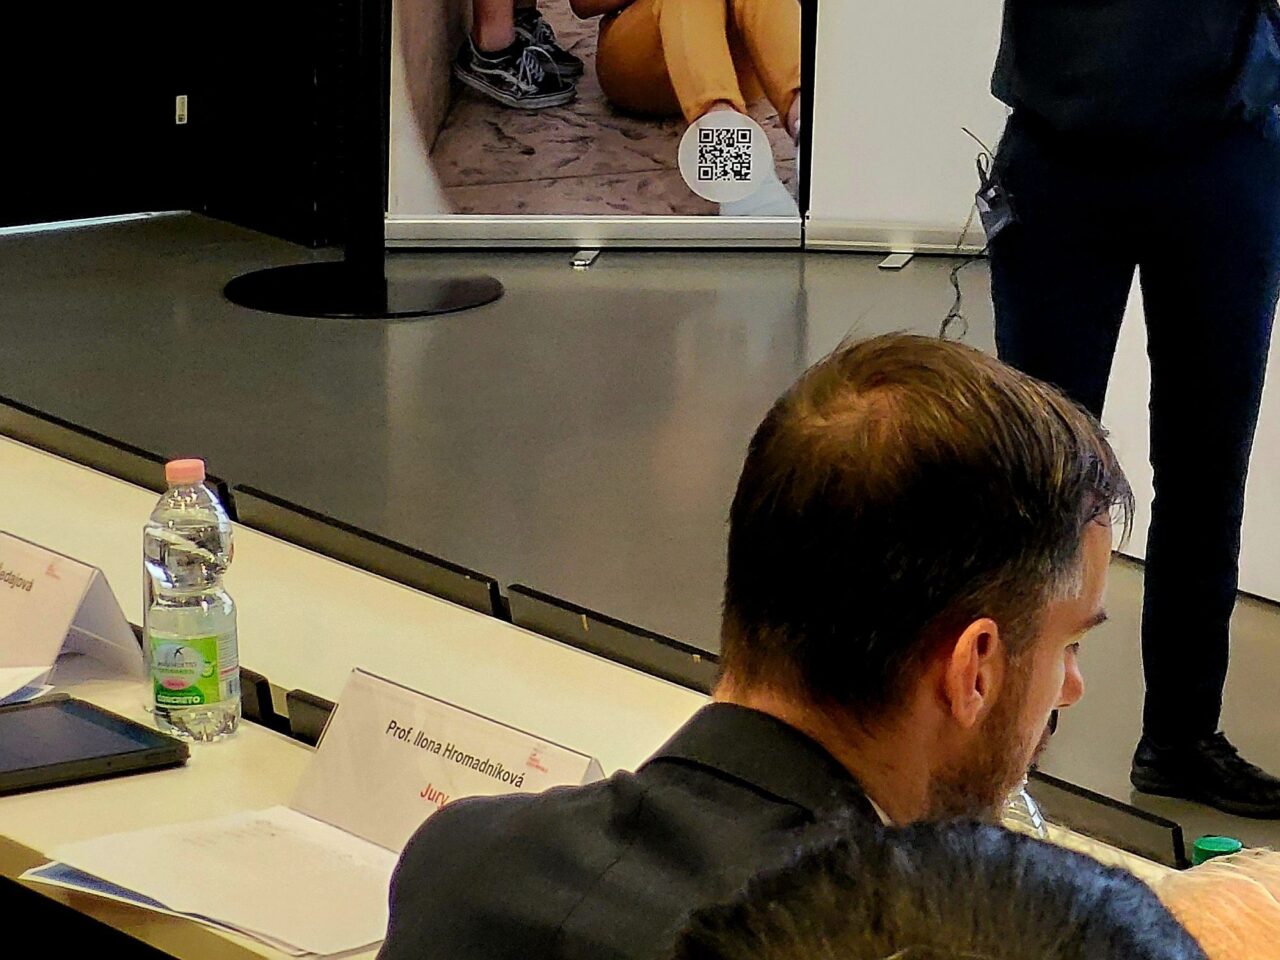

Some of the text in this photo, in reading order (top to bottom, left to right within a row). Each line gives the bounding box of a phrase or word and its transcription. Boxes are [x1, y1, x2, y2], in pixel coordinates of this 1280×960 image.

[385, 720, 413, 743] Prof.
[413, 730, 442, 755] Ilona
[441, 743, 526, 789] Hromadníková
[420, 783, 451, 811] Jury
